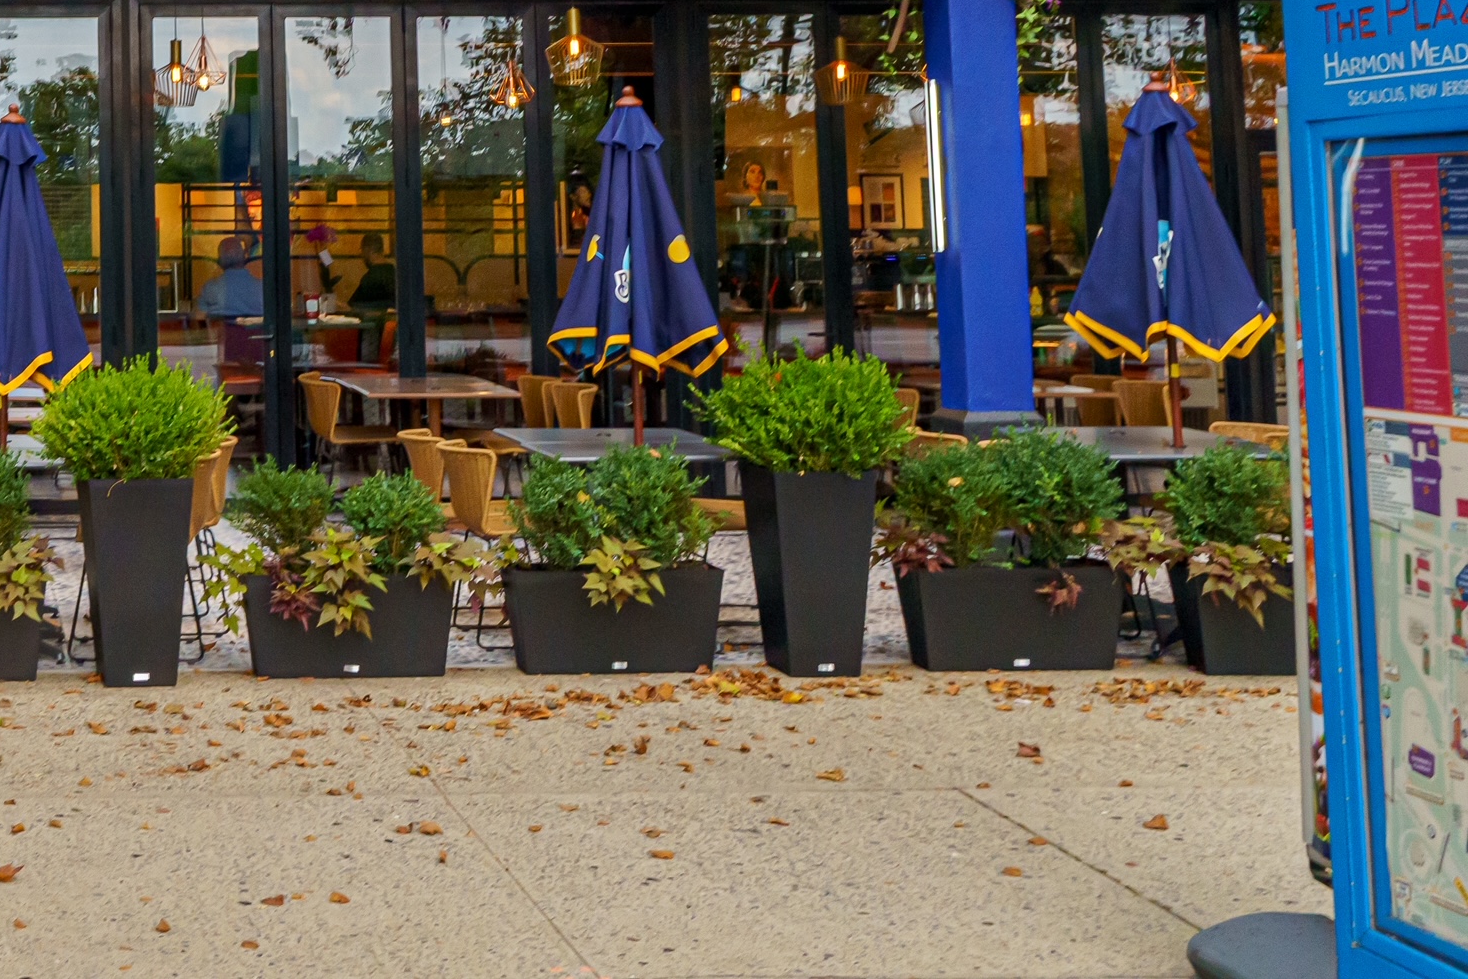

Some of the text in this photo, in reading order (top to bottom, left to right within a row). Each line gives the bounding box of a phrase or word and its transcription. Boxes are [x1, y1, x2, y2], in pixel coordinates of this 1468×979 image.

[1316, 2, 1377, 44] THE
[1323, 51, 1405, 79] HARMON
[1347, 85, 1408, 107] SECAUCUS,
[1410, 82, 1438, 101] NEW
